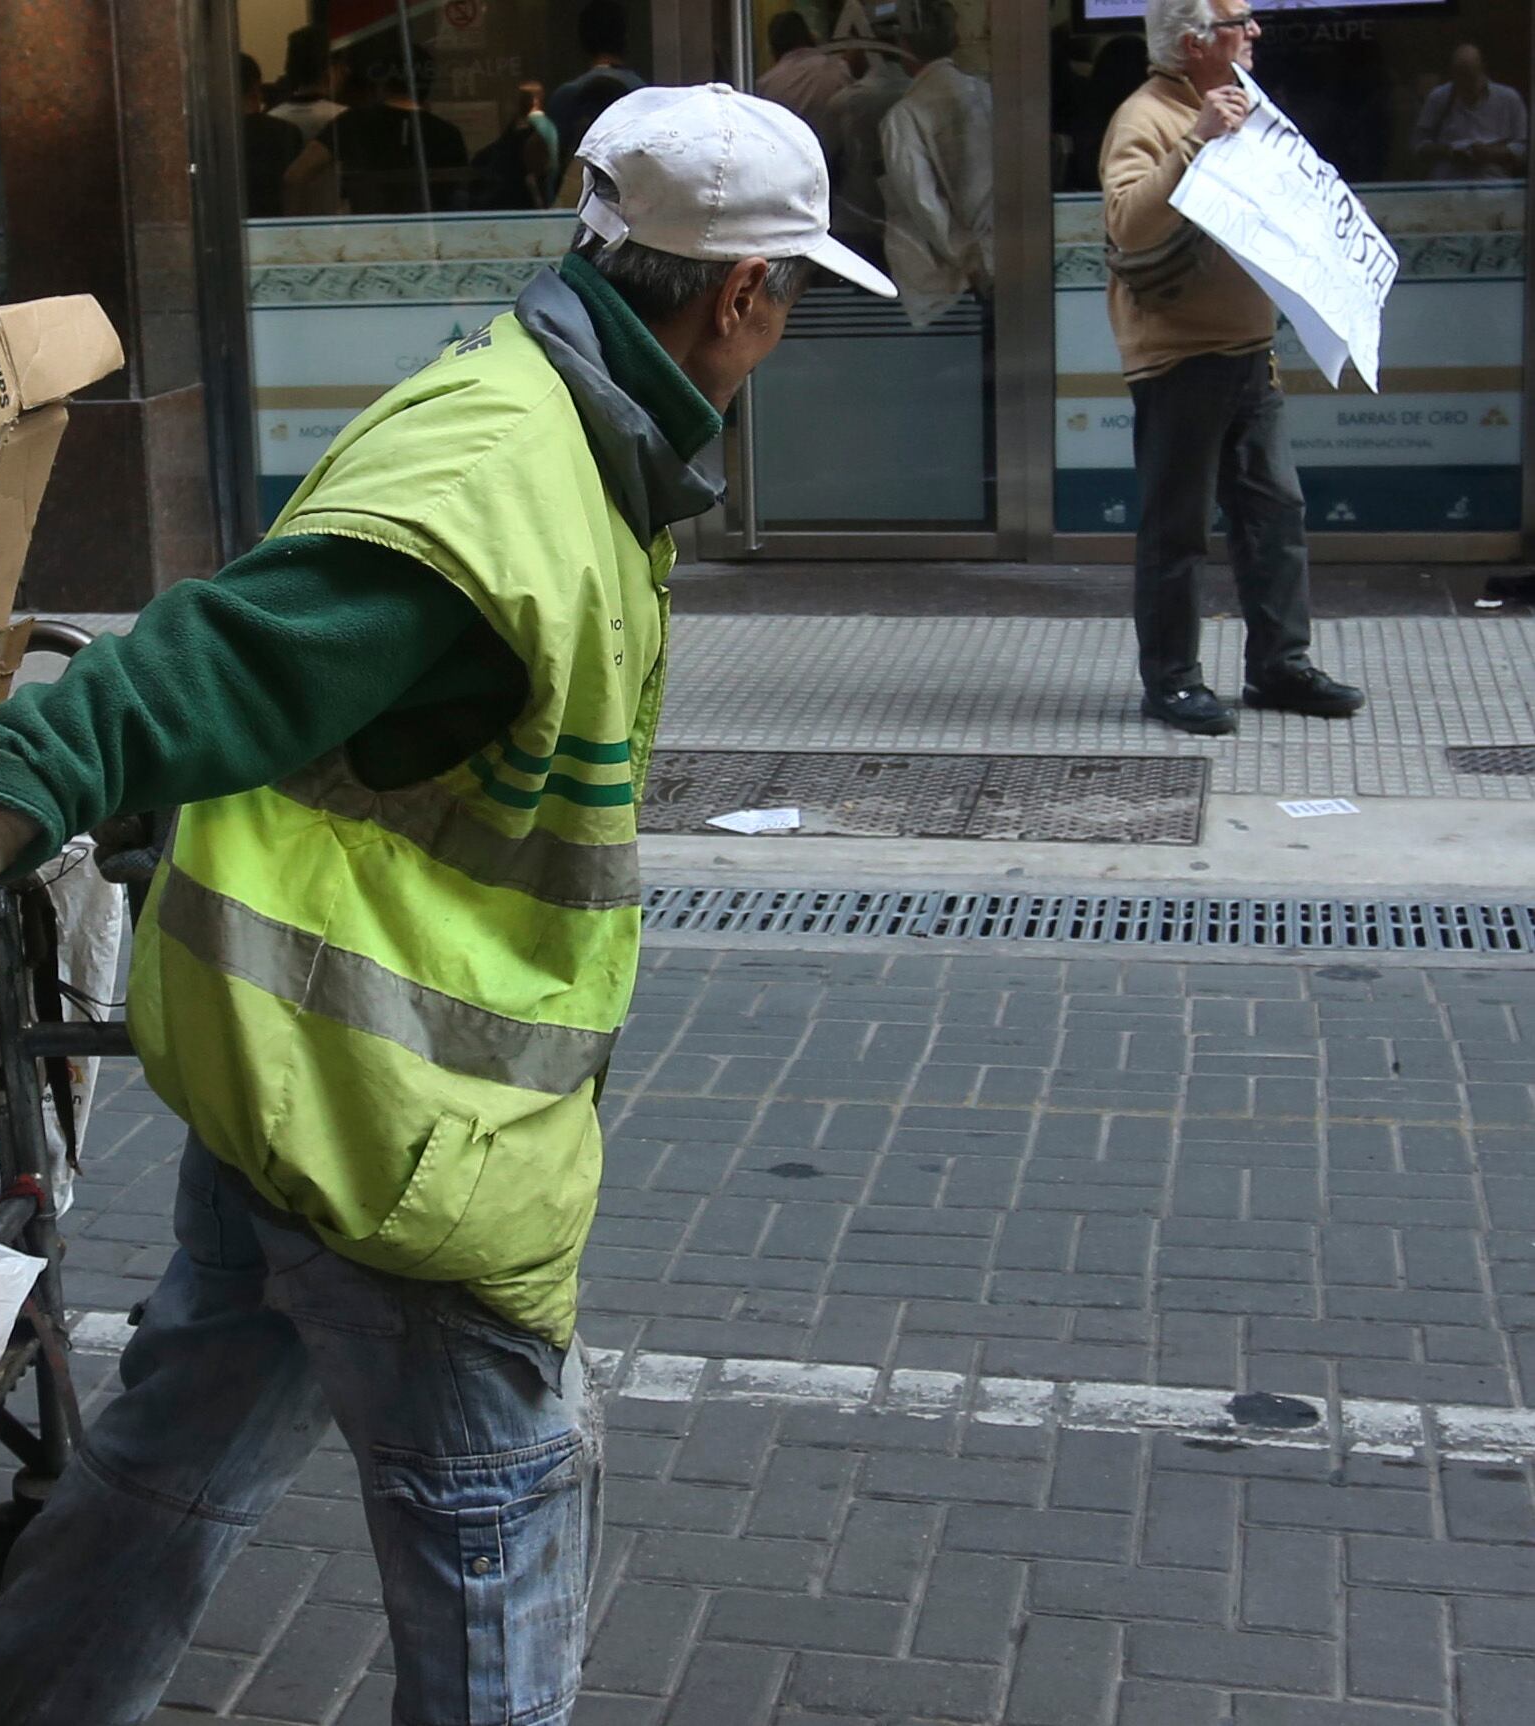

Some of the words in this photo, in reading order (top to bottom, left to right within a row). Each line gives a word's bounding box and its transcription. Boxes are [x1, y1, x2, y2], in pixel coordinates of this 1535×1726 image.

[1338, 410, 1396, 426] BARRAS
[1400, 410, 1422, 426] DE
[1428, 410, 1469, 426] ORO
